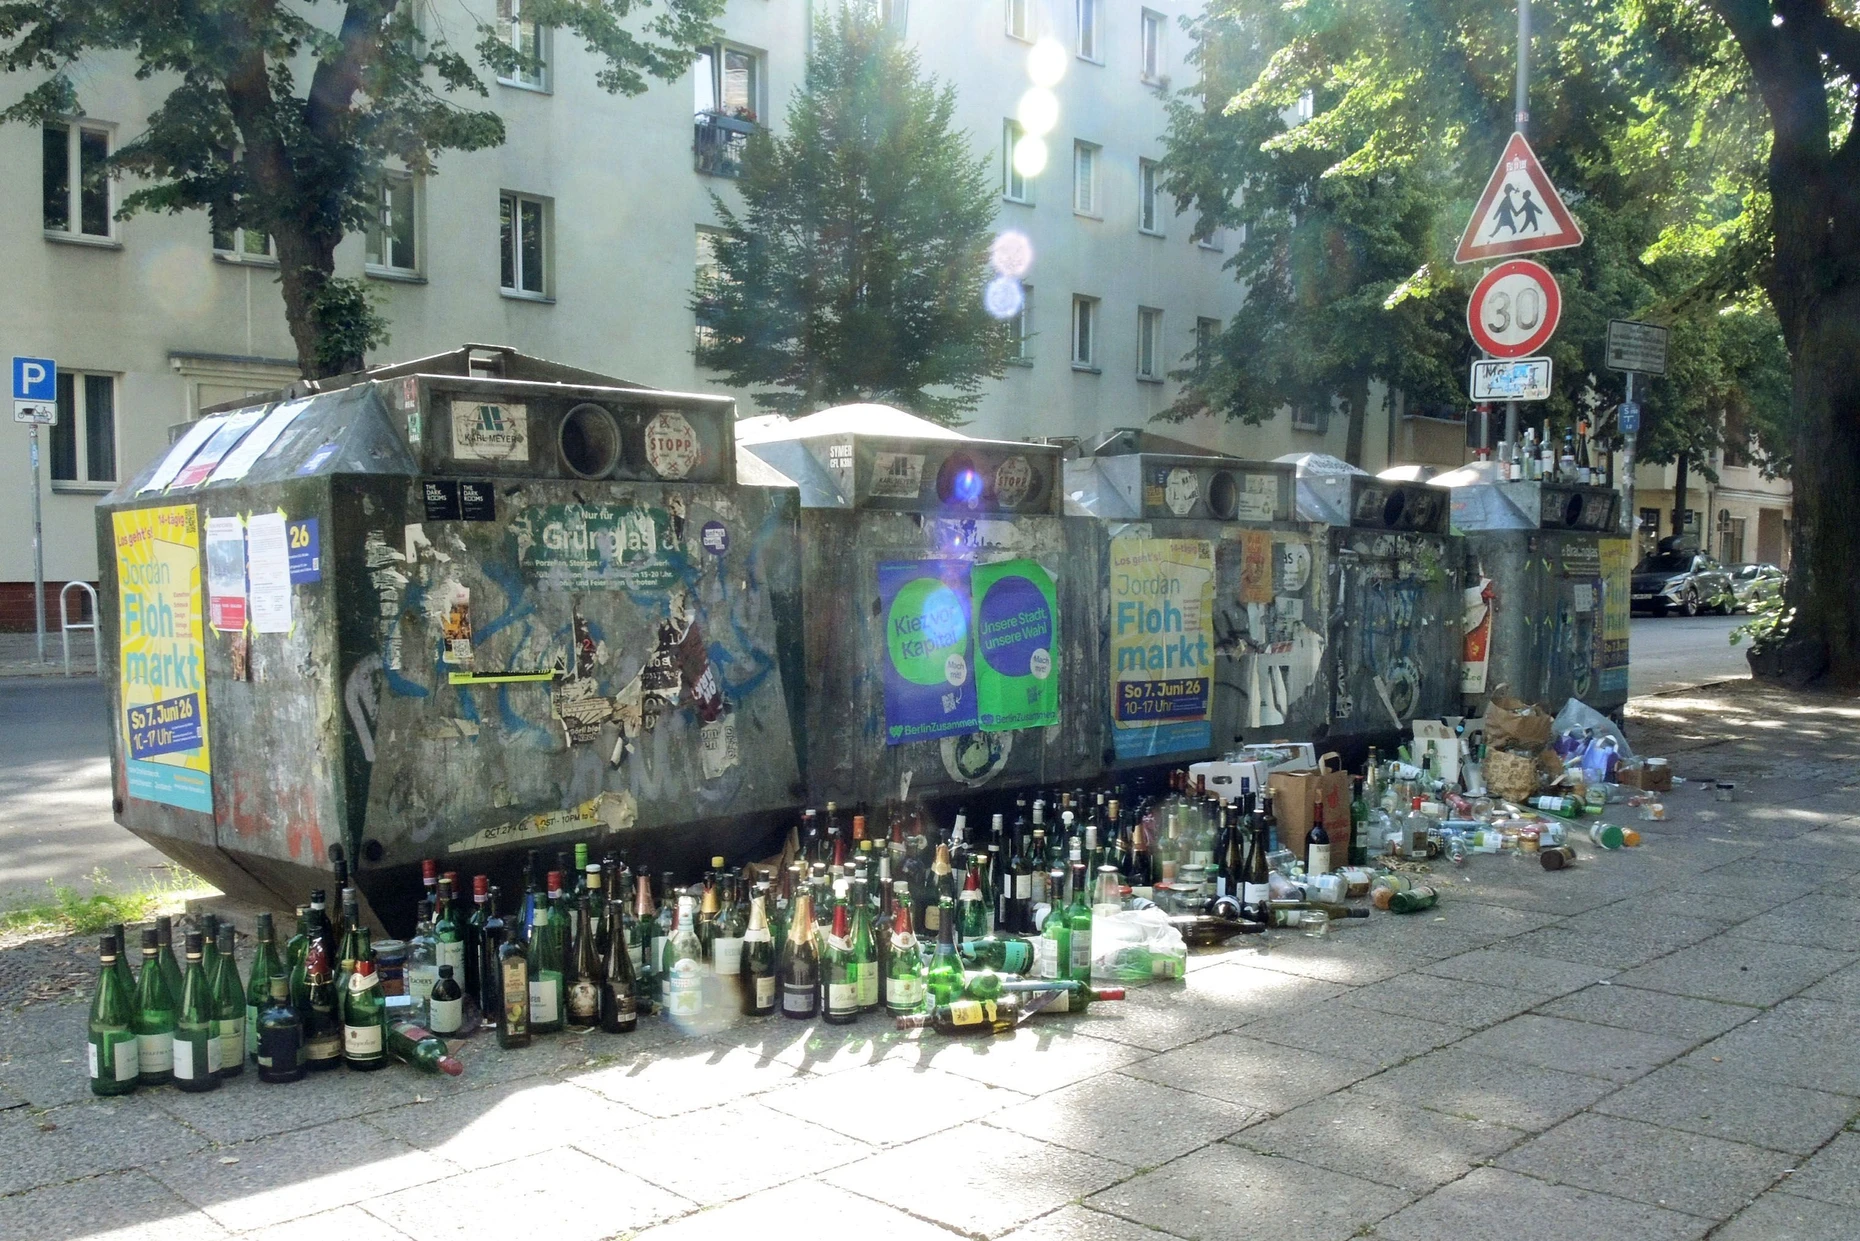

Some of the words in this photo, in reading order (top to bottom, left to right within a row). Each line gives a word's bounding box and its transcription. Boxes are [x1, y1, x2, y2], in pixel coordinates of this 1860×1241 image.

[1488, 288, 1539, 333] 30
[23, 363, 45, 394] P
[465, 433, 486, 442] KARL
[489, 434, 516, 443] MEYER
[650, 437, 691, 452] STOPP
[830, 445, 852, 458] SYMER
[998, 476, 1027, 487] STOPP
[158, 513, 184, 527] 14-tägig
[582, 510, 598, 520] Nur
[599, 509, 614, 520] für
[117, 535, 128, 546] Los
[290, 524, 309, 548] 26
[121, 557, 170, 585] Jordan
[1115, 557, 1131, 566] Los
[1117, 574, 1180, 595] Jordan
[125, 592, 174, 637] Floh
[895, 614, 928, 637] Kiez
[931, 606, 955, 625] vor
[1117, 600, 1182, 634] Floh
[980, 616, 1018, 635] Unsere
[901, 631, 957, 660] Kapital
[985, 634, 1021, 650] unsere
[1022, 624, 1047, 640] Wahl
[1033, 655, 1050, 665] Mach
[1117, 634, 1209, 672] markt
[126, 643, 200, 690] markt
[947, 661, 965, 670] Mach
[1124, 684, 1142, 699] So
[1144, 683, 1155, 697] 7.
[1157, 681, 1184, 697] Juni
[1185, 680, 1201, 694] 26
[131, 711, 145, 729] So
[146, 708, 156, 726] 7.
[157, 700, 178, 724] Juni
[179, 698, 193, 719] 26
[1125, 701, 1153, 714] 10-17
[1155, 699, 1173, 712] Uhr
[904, 718, 978, 735] BerlinZusammen
[995, 711, 1056, 724] BerlinZusammen
[157, 728, 173, 745] Uhr
